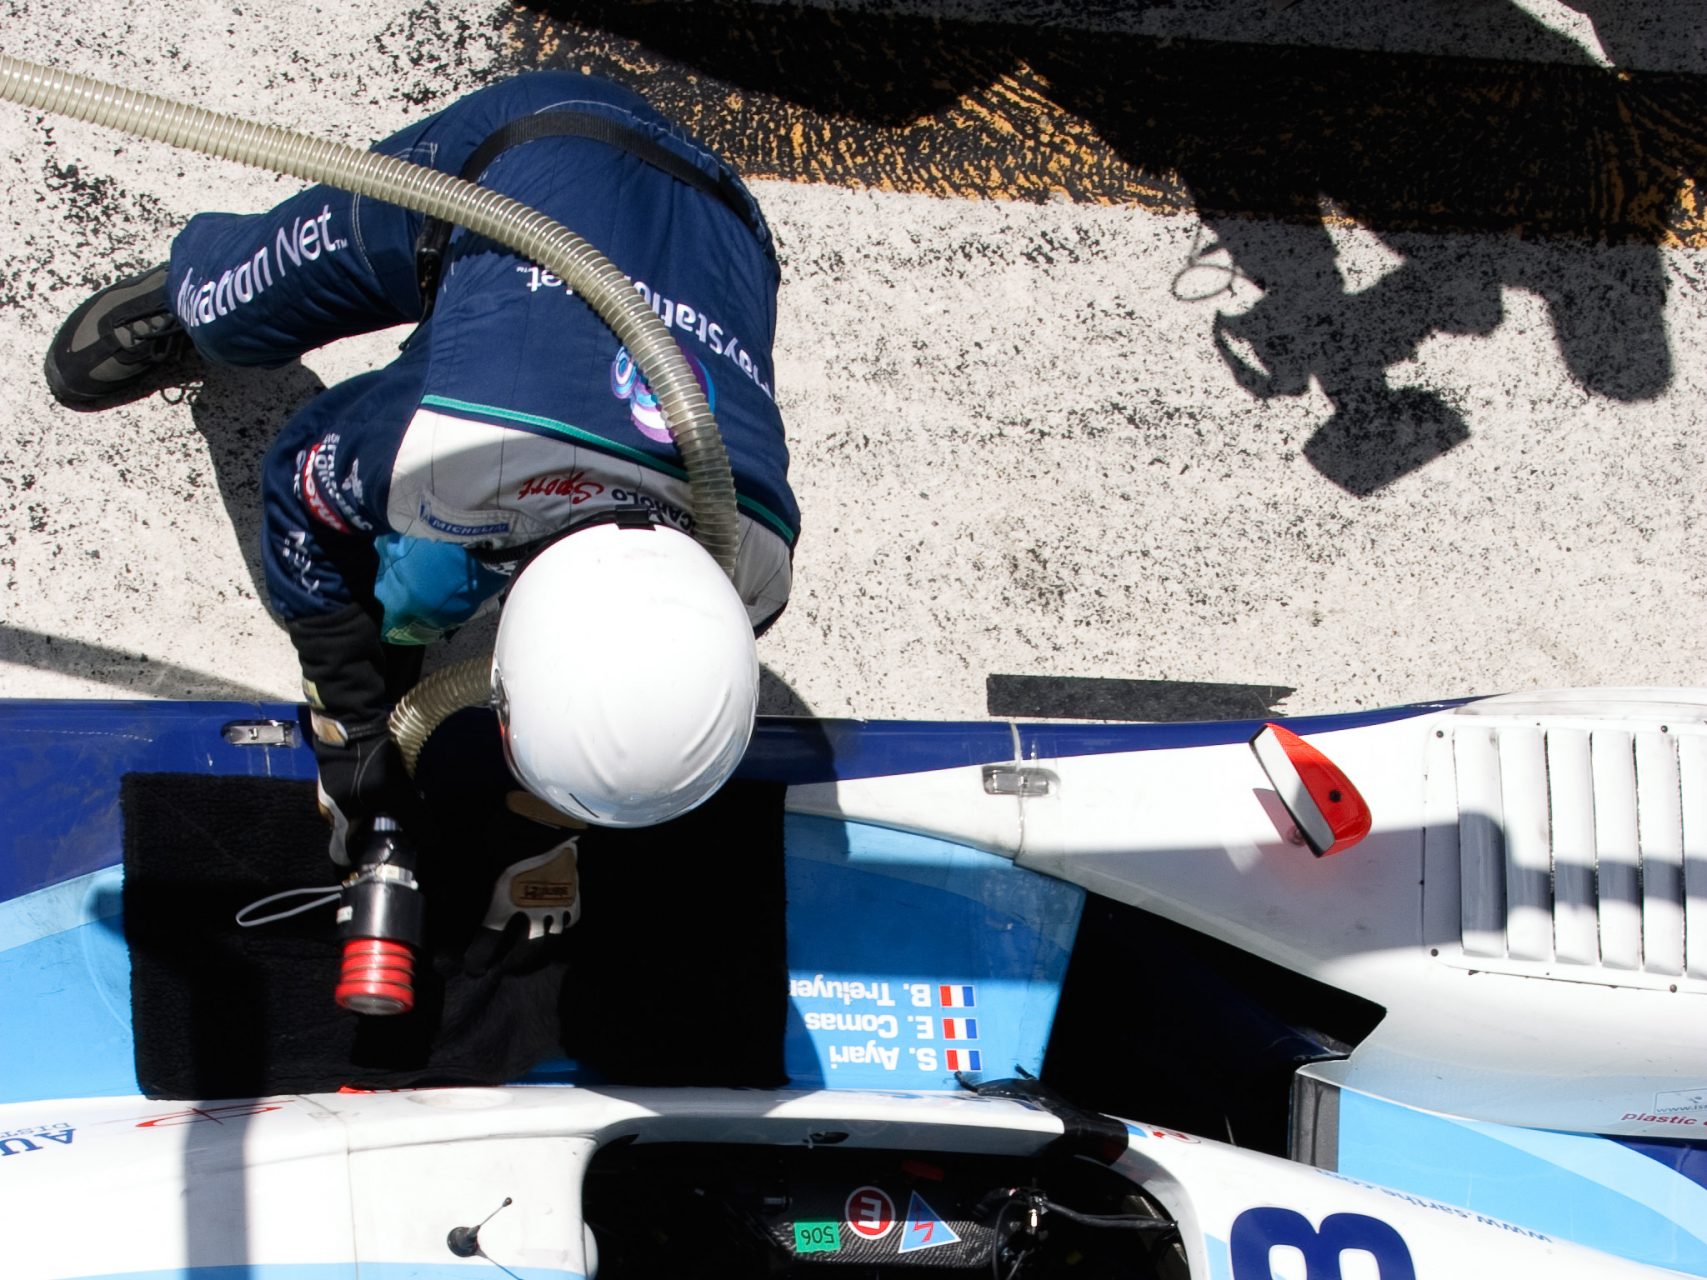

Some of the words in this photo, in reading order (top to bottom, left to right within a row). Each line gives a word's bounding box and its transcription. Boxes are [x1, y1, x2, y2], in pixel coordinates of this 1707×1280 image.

[518, 471, 605, 506] Sport
[903, 982, 931, 1007] B.
[804, 1012, 898, 1039] Comas
[906, 1015, 934, 1039] E.
[829, 1040, 900, 1071] Ayari
[908, 1046, 938, 1071] S.
[1620, 1113, 1698, 1125] plastic
